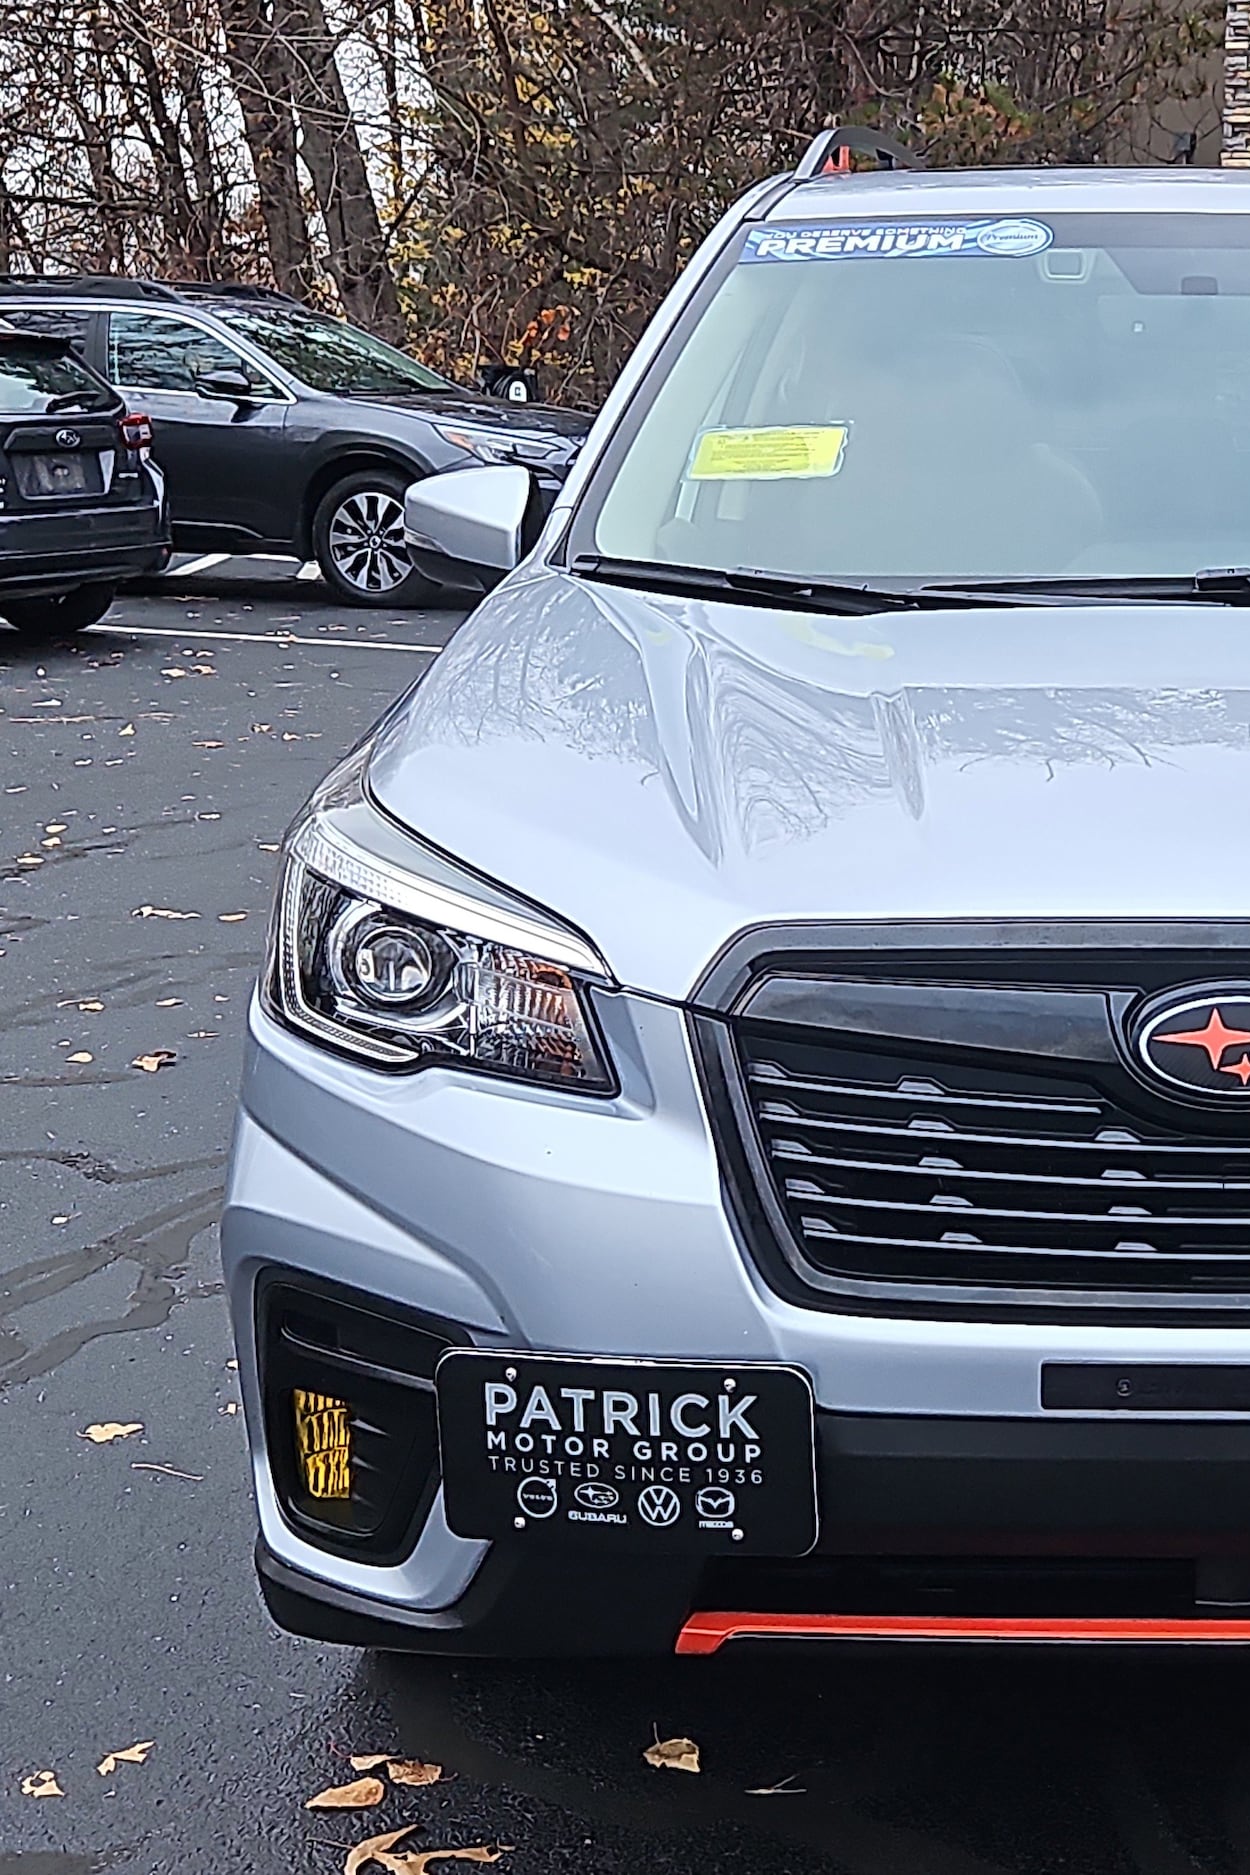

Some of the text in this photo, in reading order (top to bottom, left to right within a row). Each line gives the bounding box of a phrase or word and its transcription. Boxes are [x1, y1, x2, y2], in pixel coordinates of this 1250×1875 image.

[801, 229, 871, 237] DESERVE
[875, 227, 967, 236] SOMETHING
[756, 234, 965, 256] PREMIUM
[485, 1382, 760, 1439] PATRICK
[487, 1431, 761, 1463] MOTOR GROUP
[488, 1456, 762, 1484] TRUSTED SINCE 1936
[568, 1510, 627, 1524] SUBARU
